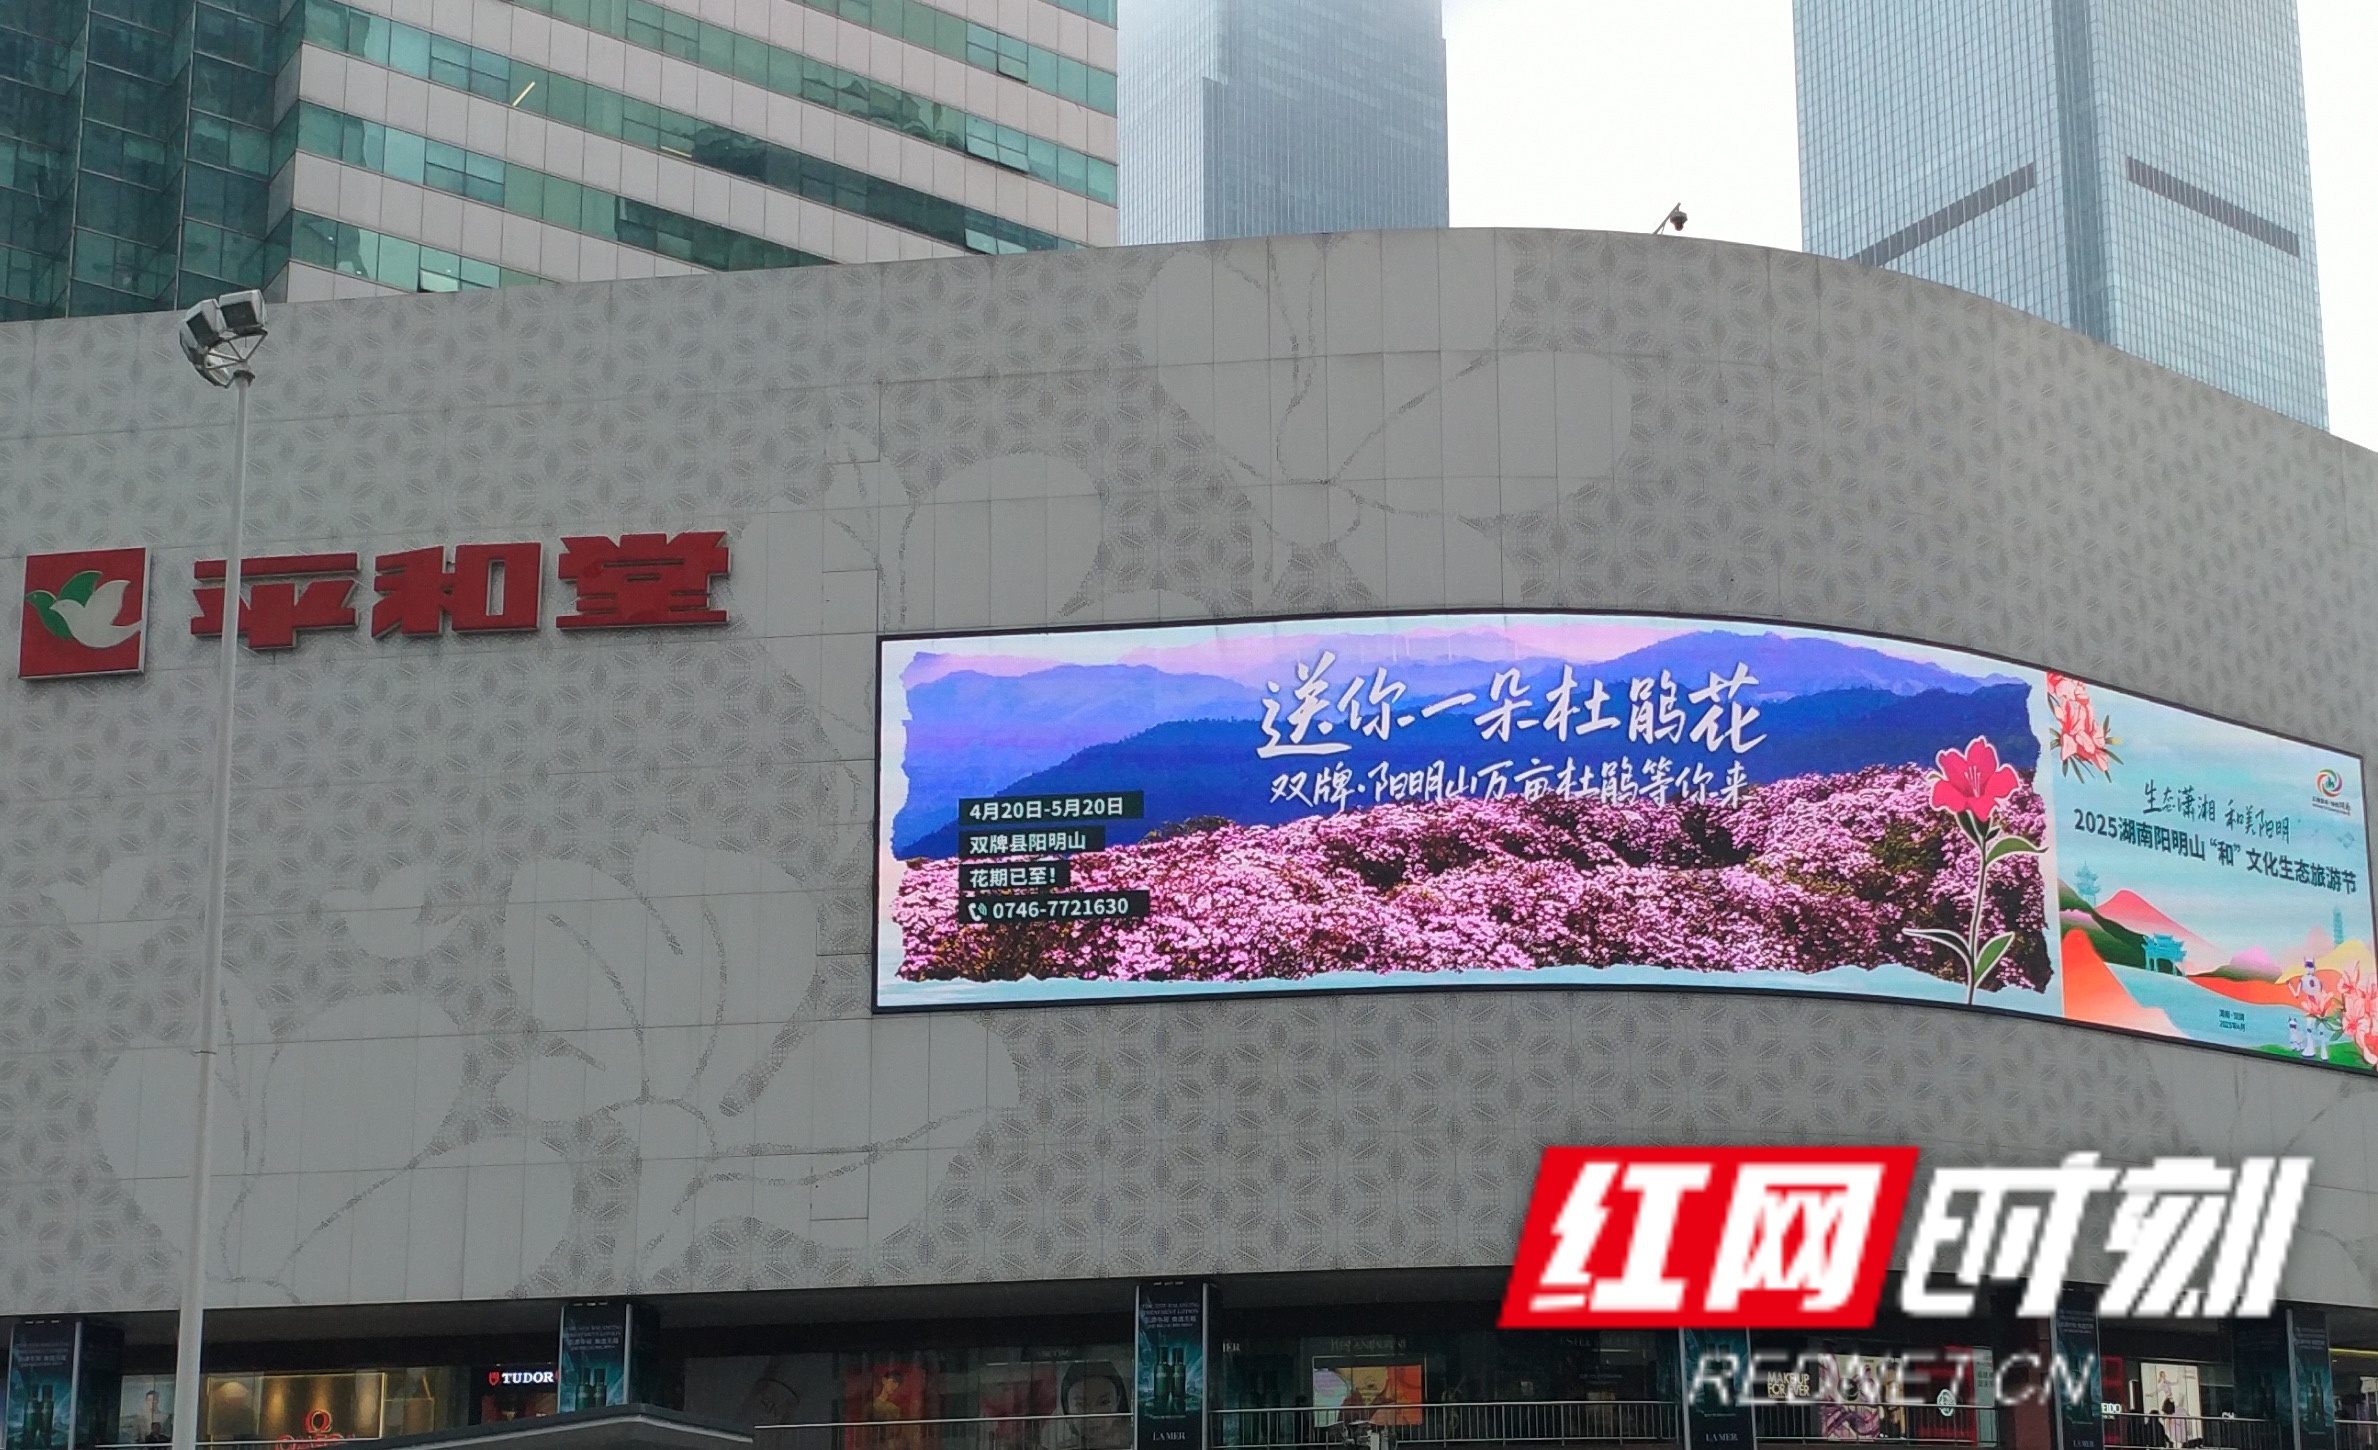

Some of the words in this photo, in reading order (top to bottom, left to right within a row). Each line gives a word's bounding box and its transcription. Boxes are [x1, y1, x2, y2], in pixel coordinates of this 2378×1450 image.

[190, 530, 732, 650] 平和堂
[1255, 651, 1768, 759] 送你一朵杜鹃花
[969, 797, 1123, 821] 4月20日-5月20日
[969, 830, 1087, 855] 双牌县阳明山
[993, 898, 1129, 920] 0746-7721630
[502, 1371, 555, 1384] TUDOR
[1166, 1431, 1186, 1440] MER
